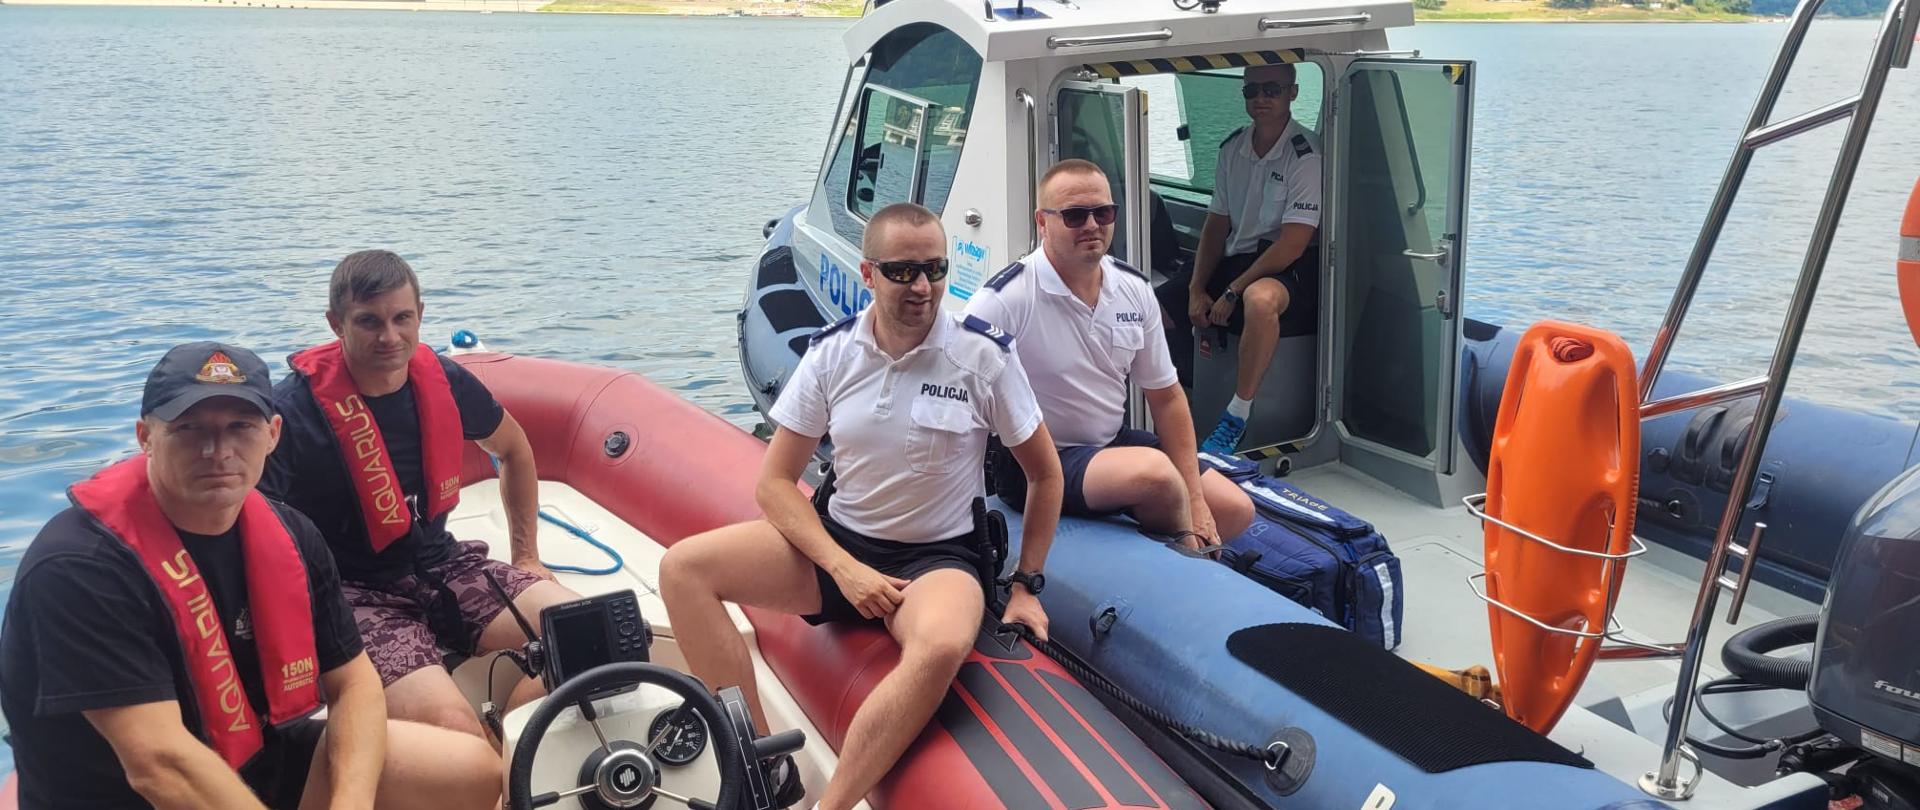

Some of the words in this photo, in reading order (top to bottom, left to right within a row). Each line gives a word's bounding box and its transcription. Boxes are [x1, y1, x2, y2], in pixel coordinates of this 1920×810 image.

[920, 383, 969, 403] POLICJA
[335, 394, 405, 525] AQUARIUS
[1282, 487, 1329, 511] TRIAGE
[161, 549, 251, 732] AQUARIUS
[281, 656, 314, 679] 150N
